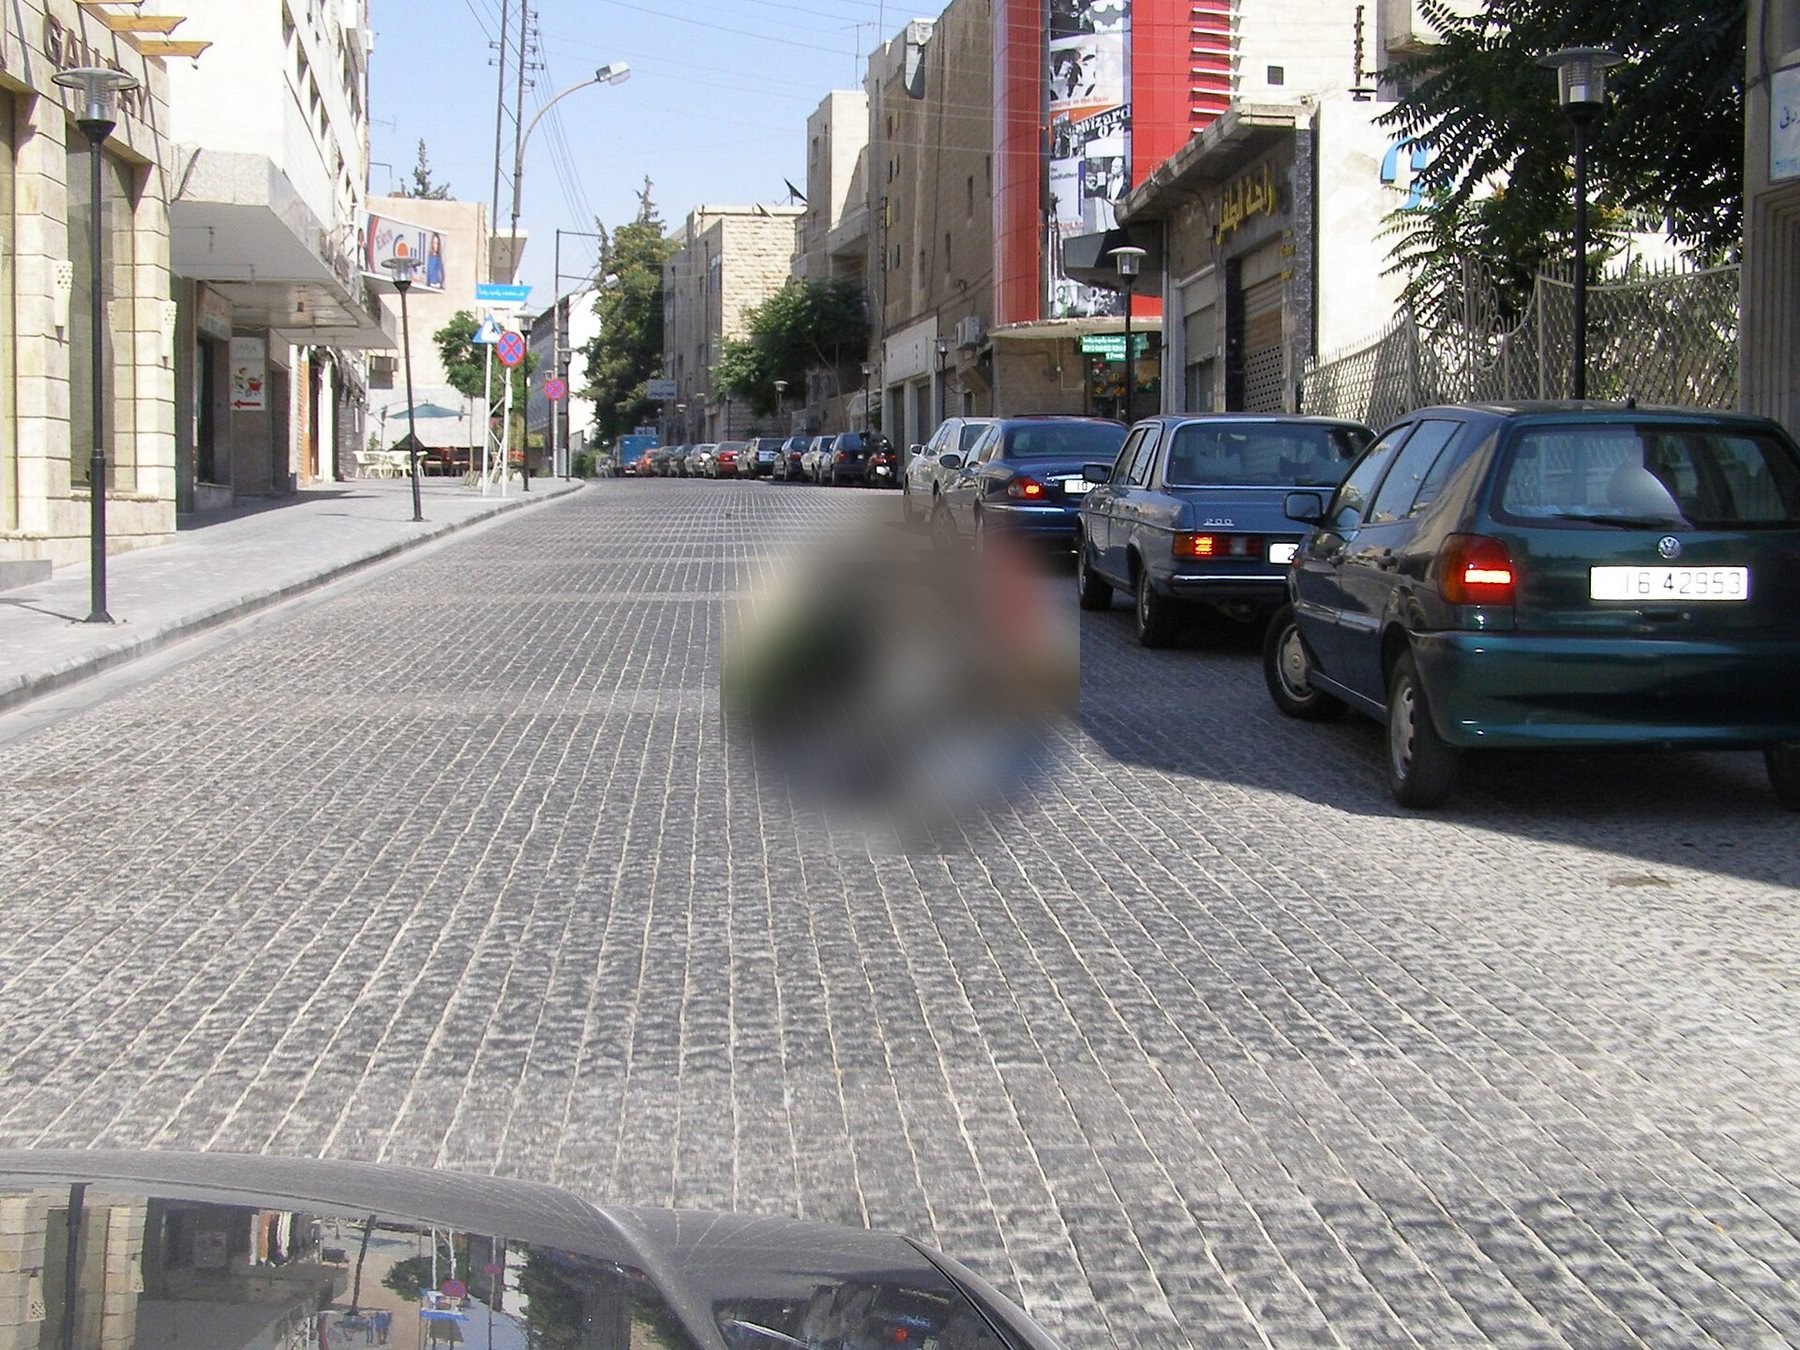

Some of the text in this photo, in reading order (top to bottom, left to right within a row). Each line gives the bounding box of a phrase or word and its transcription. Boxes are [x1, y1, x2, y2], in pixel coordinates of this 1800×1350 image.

[1080, 105, 1131, 133] Wizard
[1625, 572, 1742, 595] 16 42953
